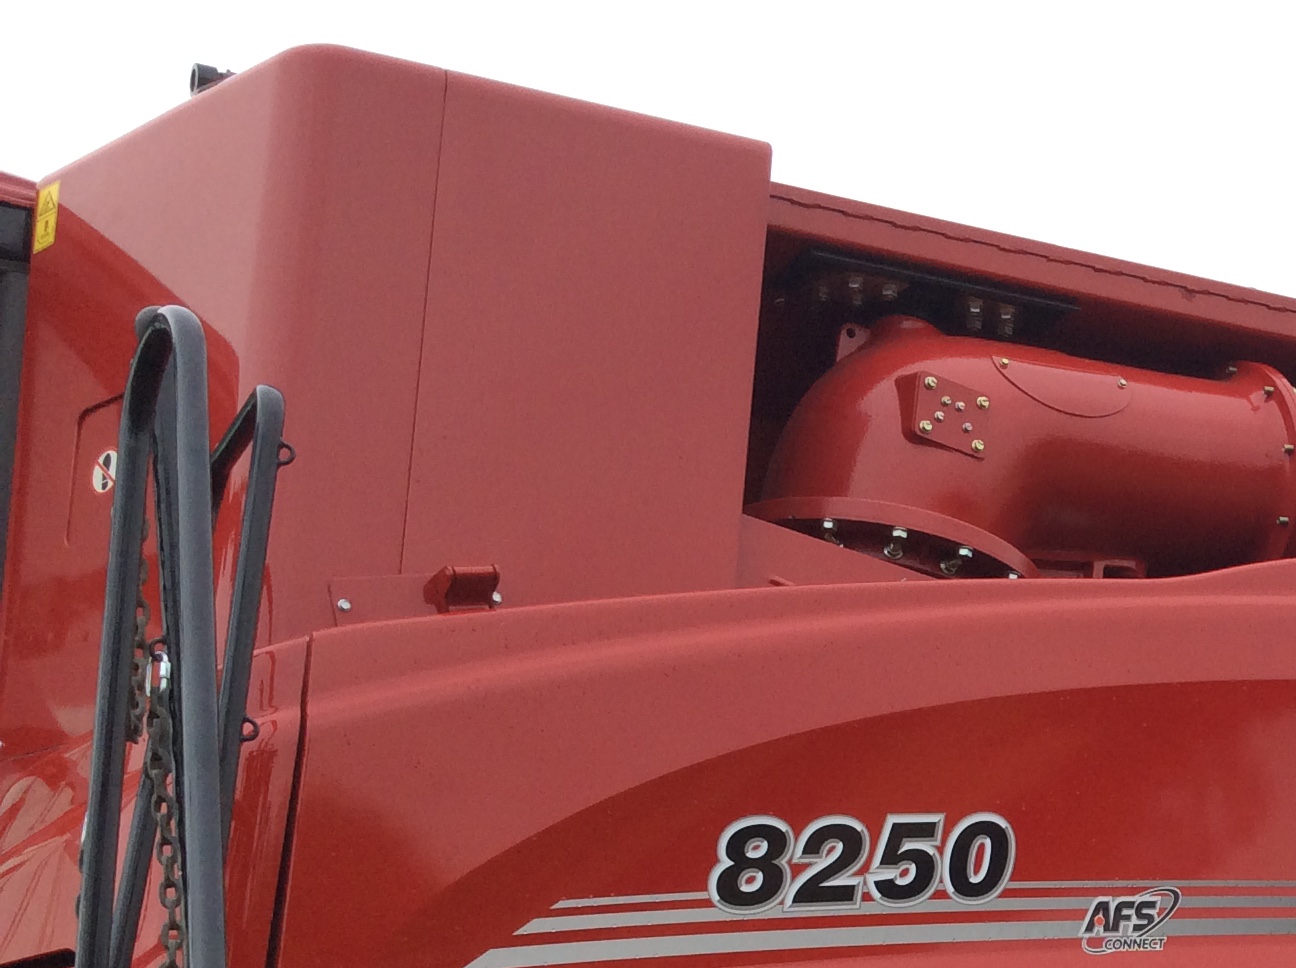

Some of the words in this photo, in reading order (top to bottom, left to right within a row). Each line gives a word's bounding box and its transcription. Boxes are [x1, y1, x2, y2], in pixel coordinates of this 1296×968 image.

[707, 813, 1017, 912] 8250
[1082, 896, 1160, 936] AFS
[1104, 937, 1167, 953] CONNECT
